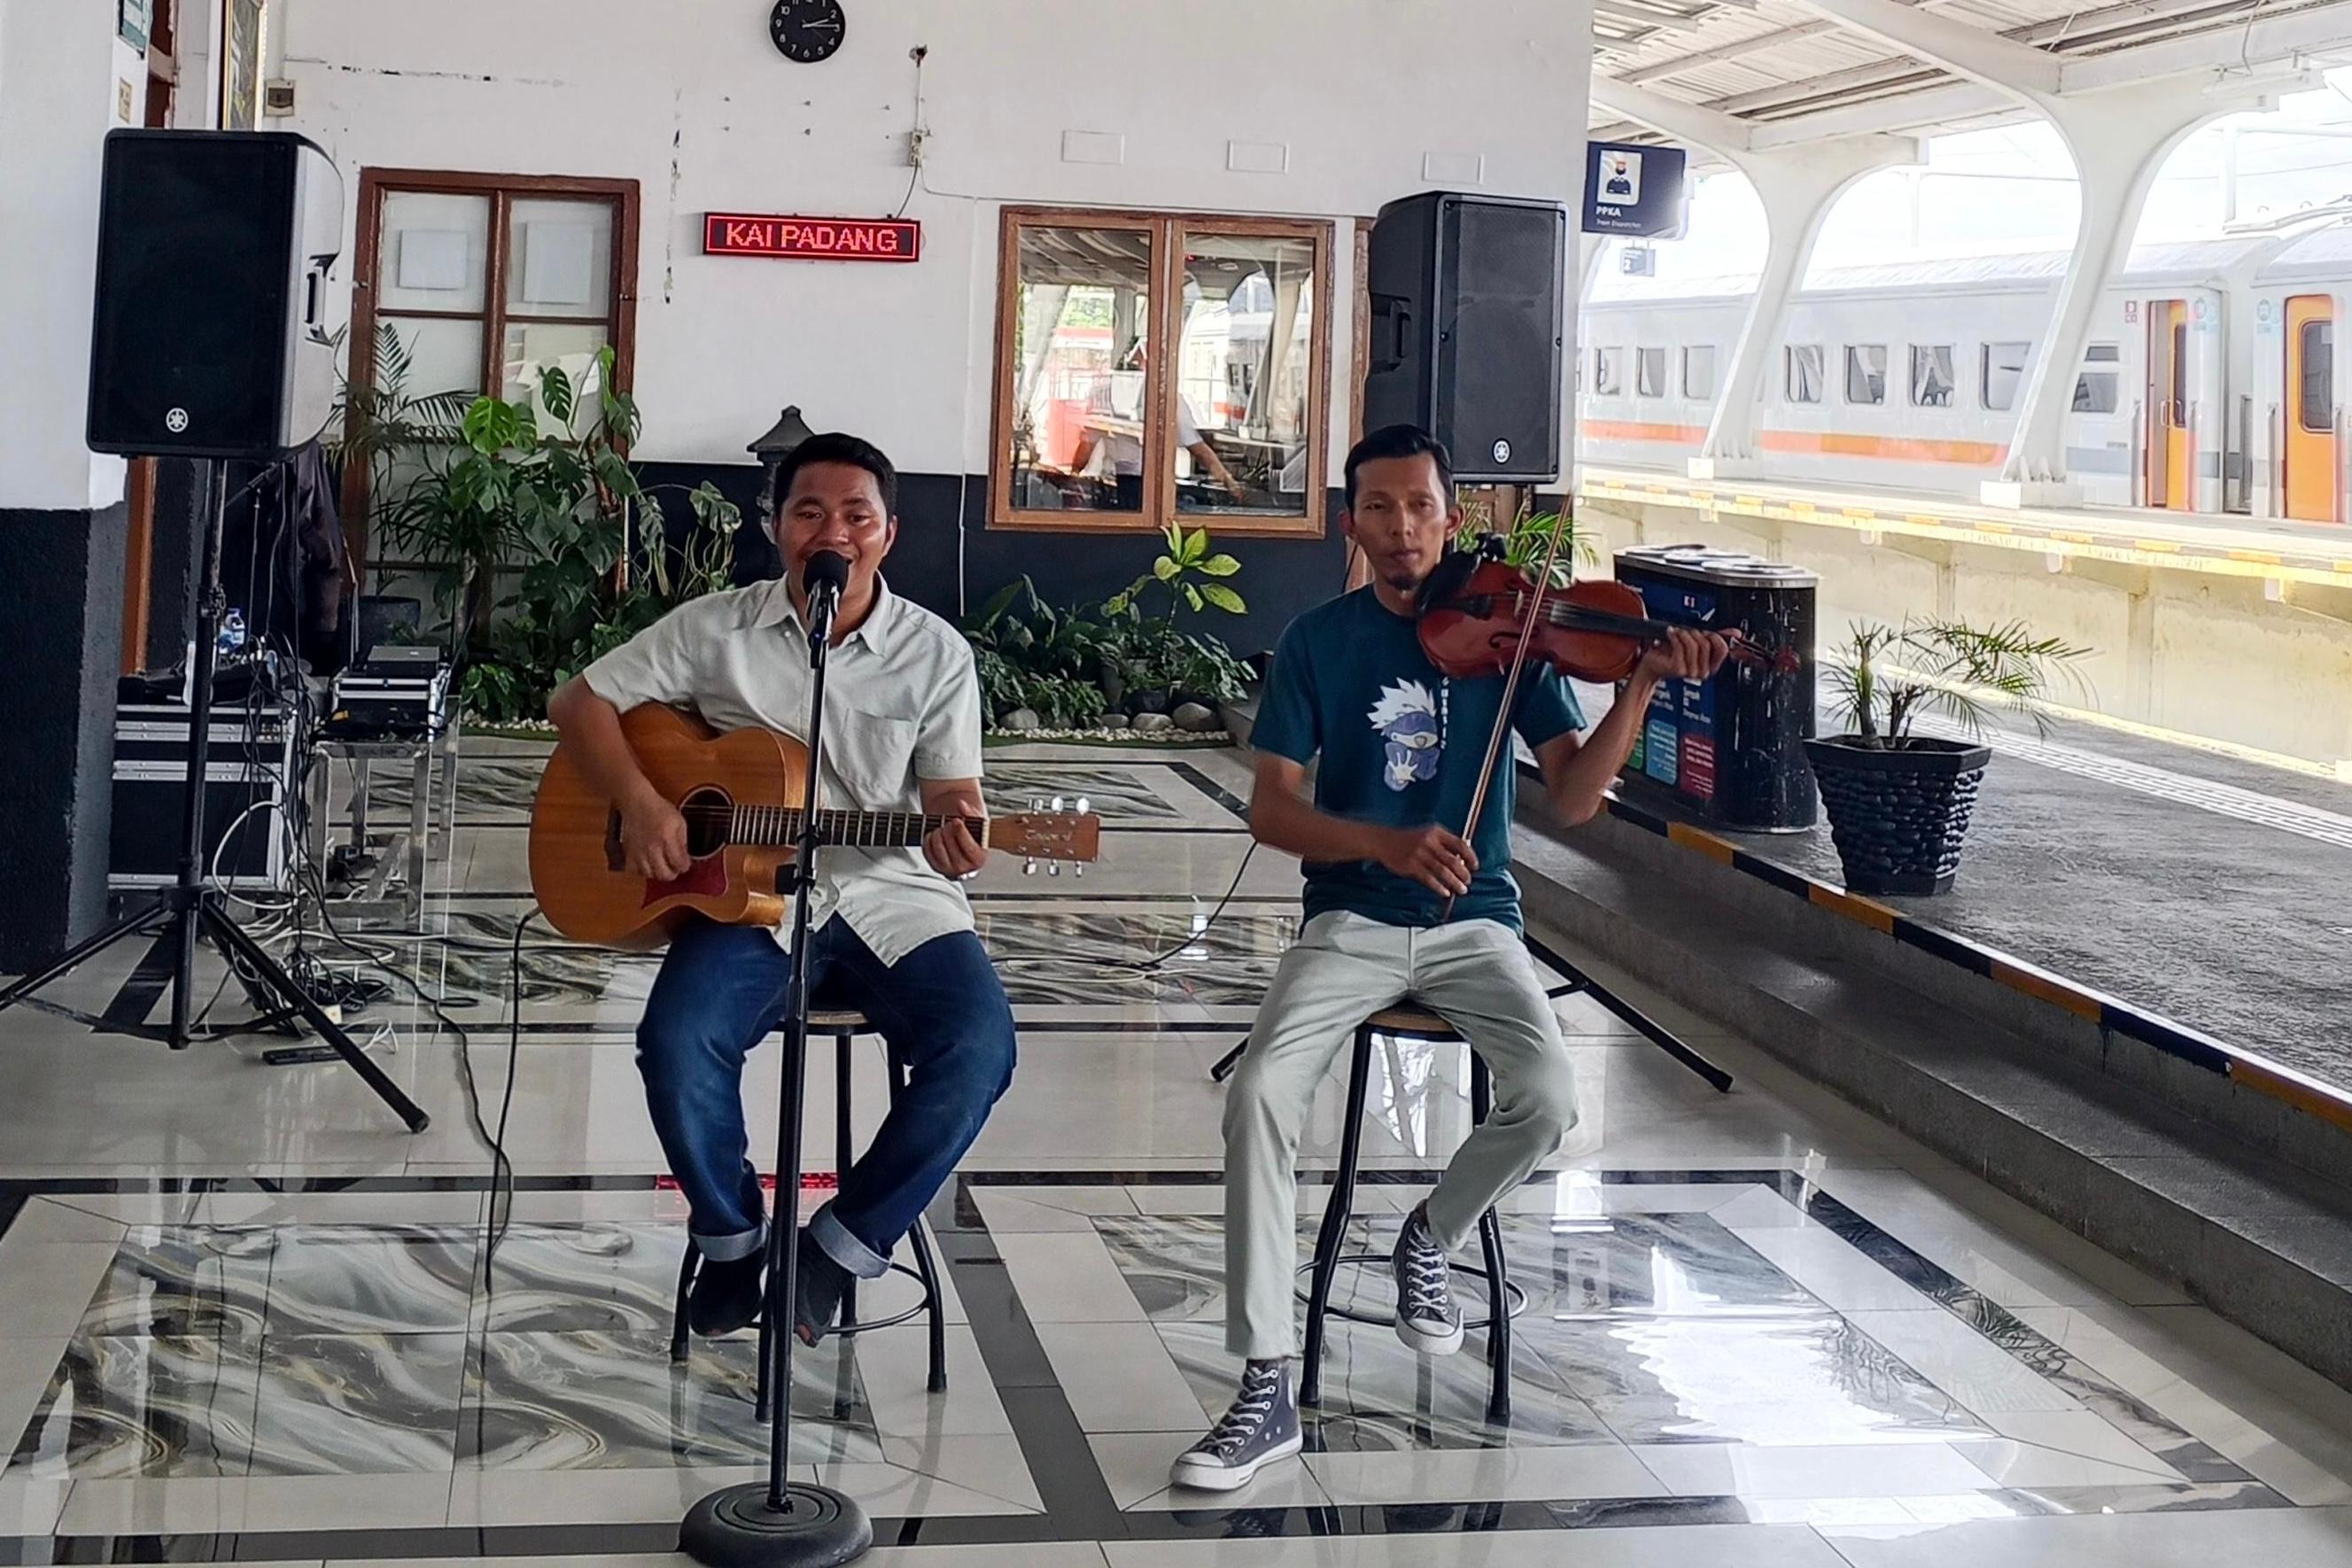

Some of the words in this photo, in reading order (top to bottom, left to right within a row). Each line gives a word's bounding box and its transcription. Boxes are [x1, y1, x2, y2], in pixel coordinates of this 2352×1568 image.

[780, 5, 790, 15] 10
[830, 9, 837, 19] 2
[775, 19, 781, 27] 9
[780, 34, 786, 43] 8
[791, 43, 796, 52] 7
[818, 46, 824, 55] 5
[803, 49, 810, 58] 6
[1595, 206, 1621, 216] PPKA
[726, 222, 772, 247] KAI
[780, 225, 897, 252] PADANG
